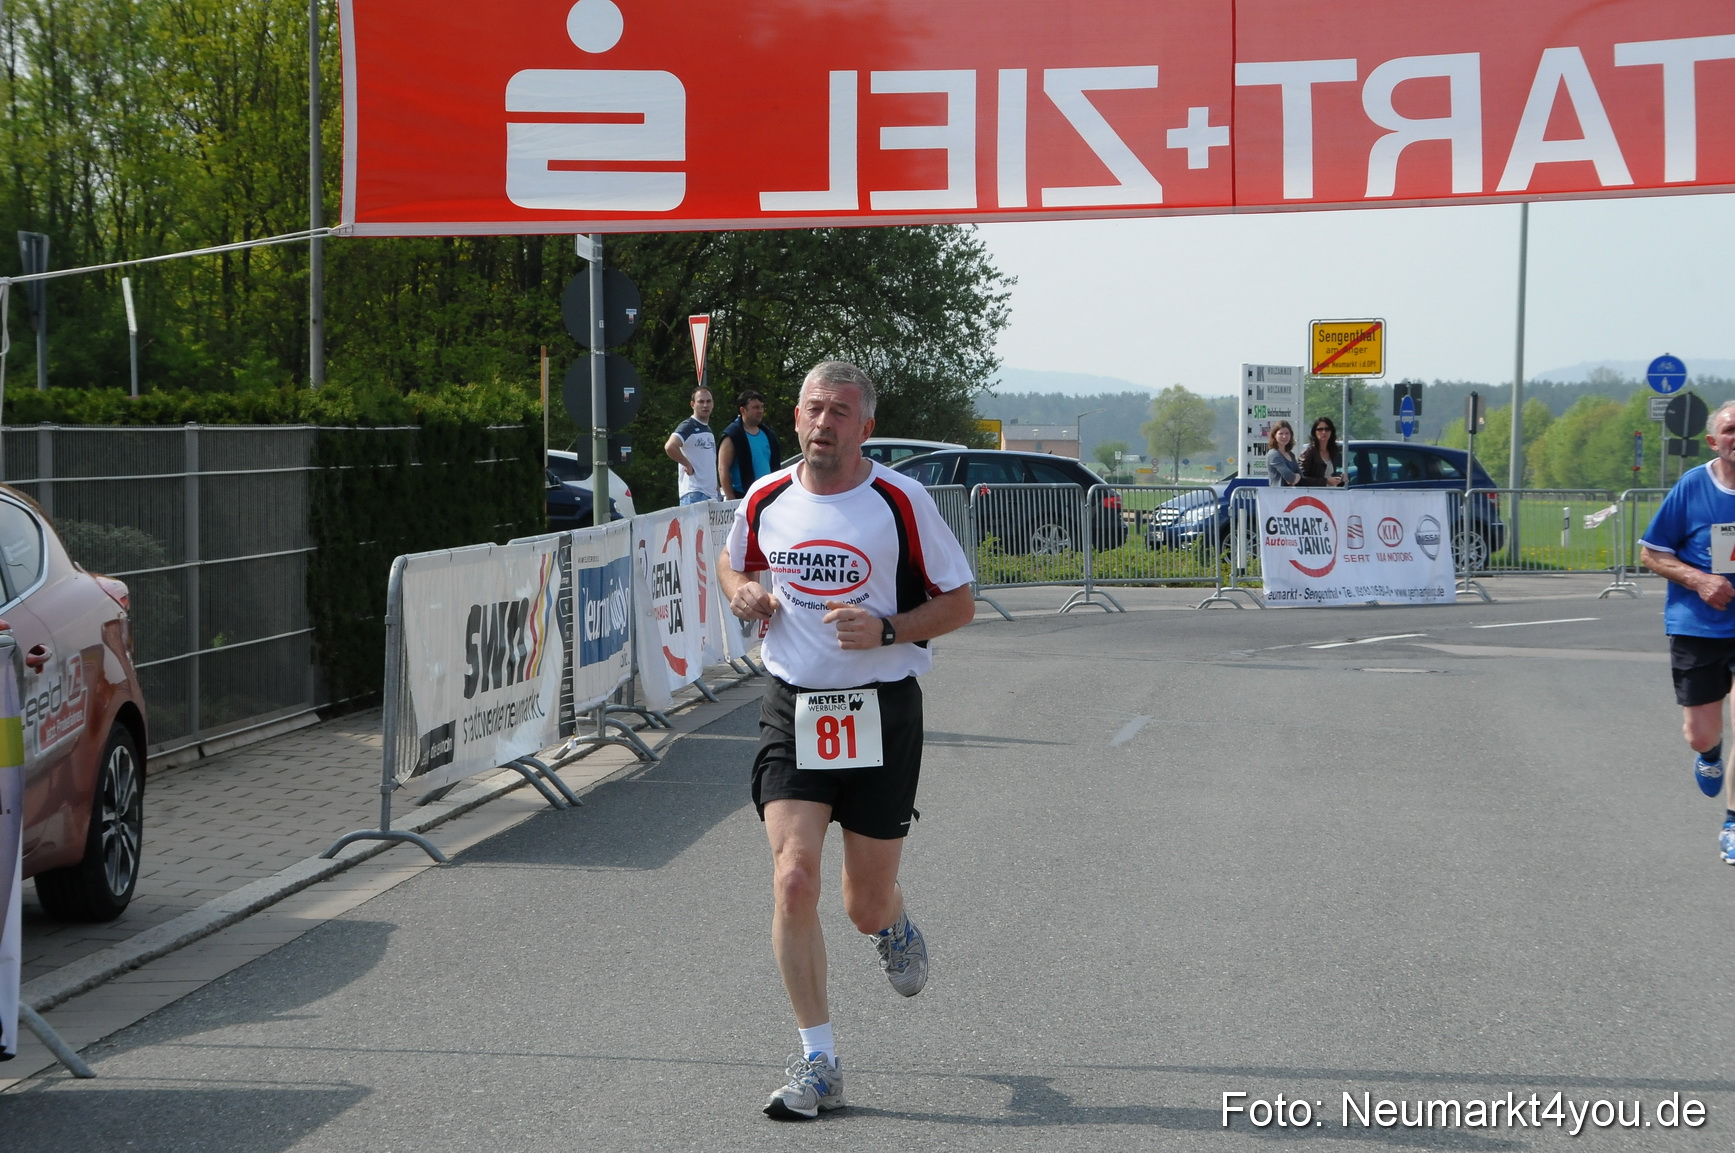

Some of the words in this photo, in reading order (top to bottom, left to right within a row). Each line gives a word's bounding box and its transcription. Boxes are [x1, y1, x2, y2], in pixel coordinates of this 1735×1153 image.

[1318, 328, 1376, 346] Sengenthal
[1265, 516, 1323, 536] GERHART
[1382, 524, 1400, 541] KIA
[1298, 536, 1333, 556] JÄNIG
[1417, 534, 1441, 543] NISSA
[769, 551, 849, 568] GERHART
[850, 560, 859, 568] &
[1343, 554, 1371, 563] SEAT
[1387, 552, 1414, 563] MOTORS
[770, 565, 801, 574] Autohaus
[800, 568, 860, 584] JÄNIG
[780, 586, 791, 601] Das
[808, 694, 846, 705] MEYER
[808, 704, 847, 712] WERBUNG
[816, 715, 857, 760] 81
